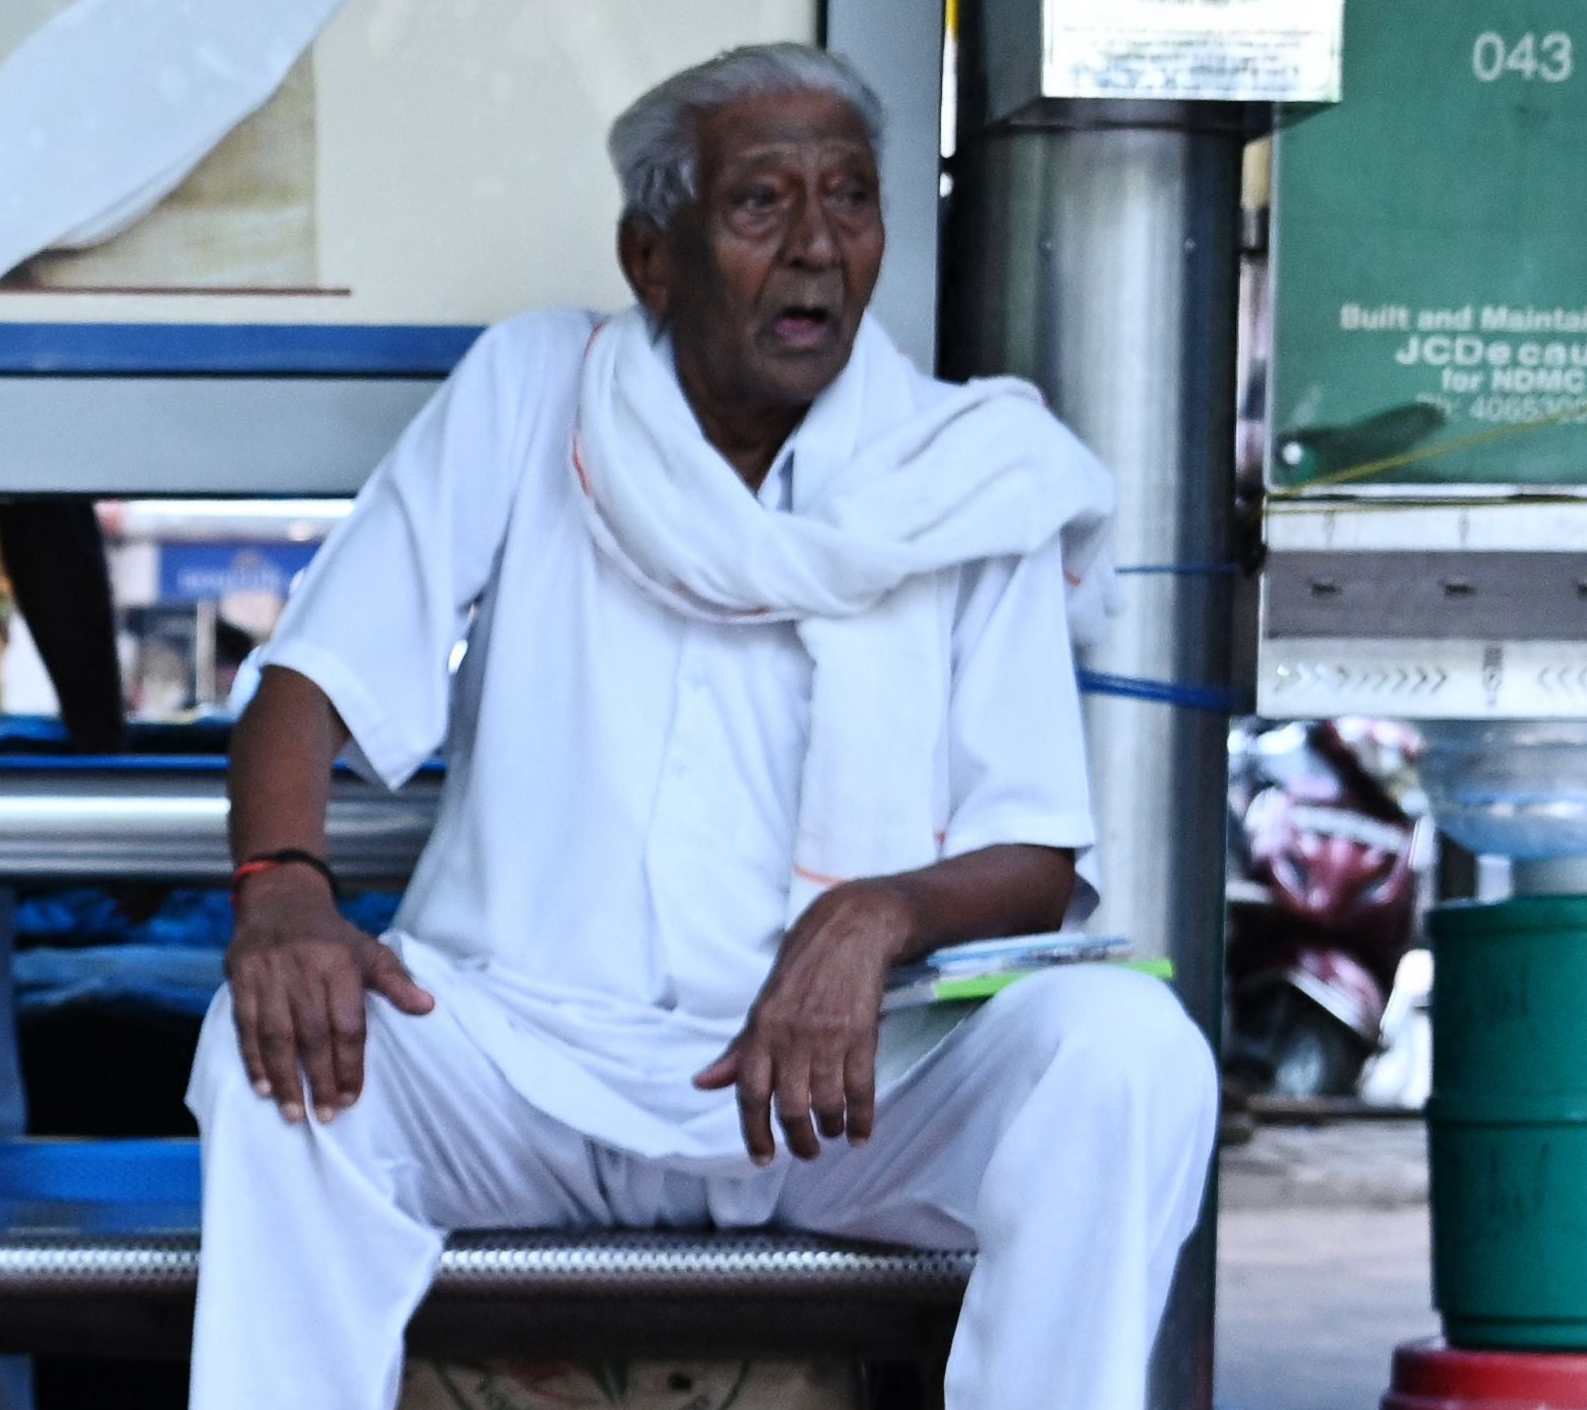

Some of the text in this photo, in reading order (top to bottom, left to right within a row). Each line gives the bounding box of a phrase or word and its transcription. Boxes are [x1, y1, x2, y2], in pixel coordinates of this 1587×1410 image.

[1471, 31, 1574, 82] 043
[1341, 303, 1410, 331] Built
[1418, 306, 1473, 332] and
[1442, 367, 1587, 394] for NDMC
